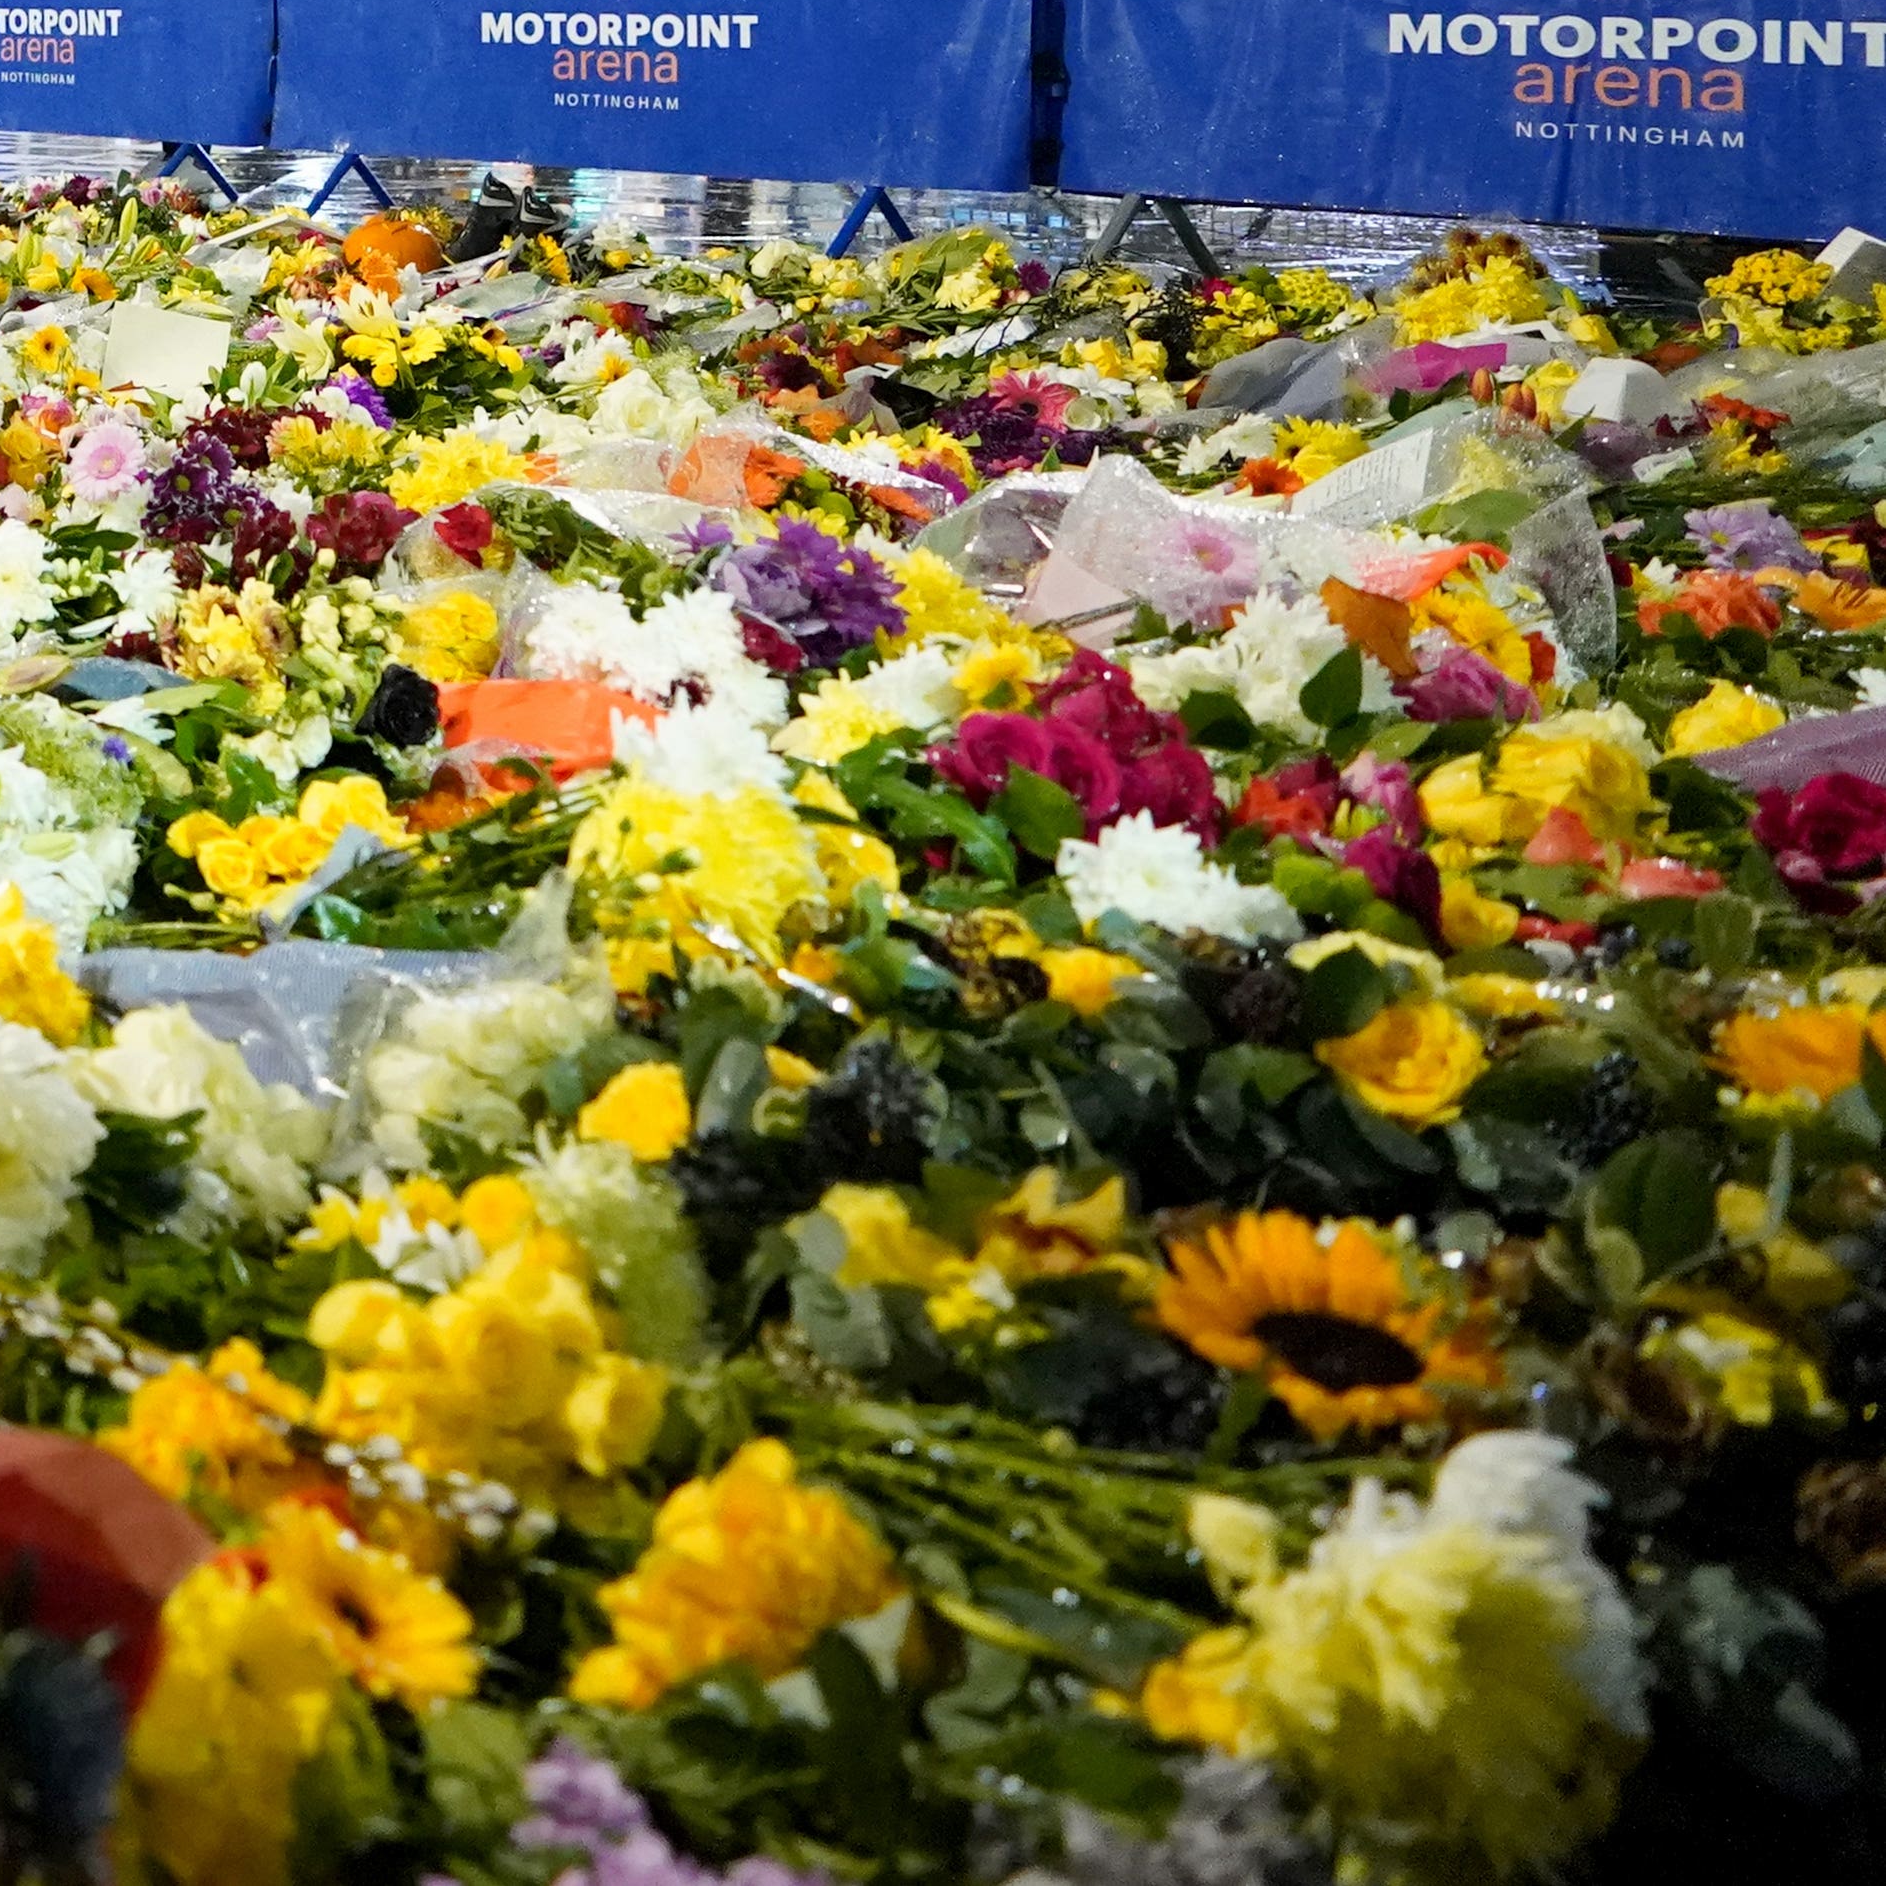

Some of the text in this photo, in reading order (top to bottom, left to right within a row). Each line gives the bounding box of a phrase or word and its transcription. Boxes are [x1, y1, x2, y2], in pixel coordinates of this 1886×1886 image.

[481, 12, 759, 49] MOTORPOINT
[1389, 13, 1886, 68] MOTORPOINT
[1, 36, 75, 64] arena
[553, 47, 679, 84] arena
[1, 71, 75, 85] NOTTINGHAM
[1514, 62, 1745, 112] arena
[554, 93, 680, 111] NOTTINGHAM
[1515, 121, 1745, 148] NOTTINGHAM
